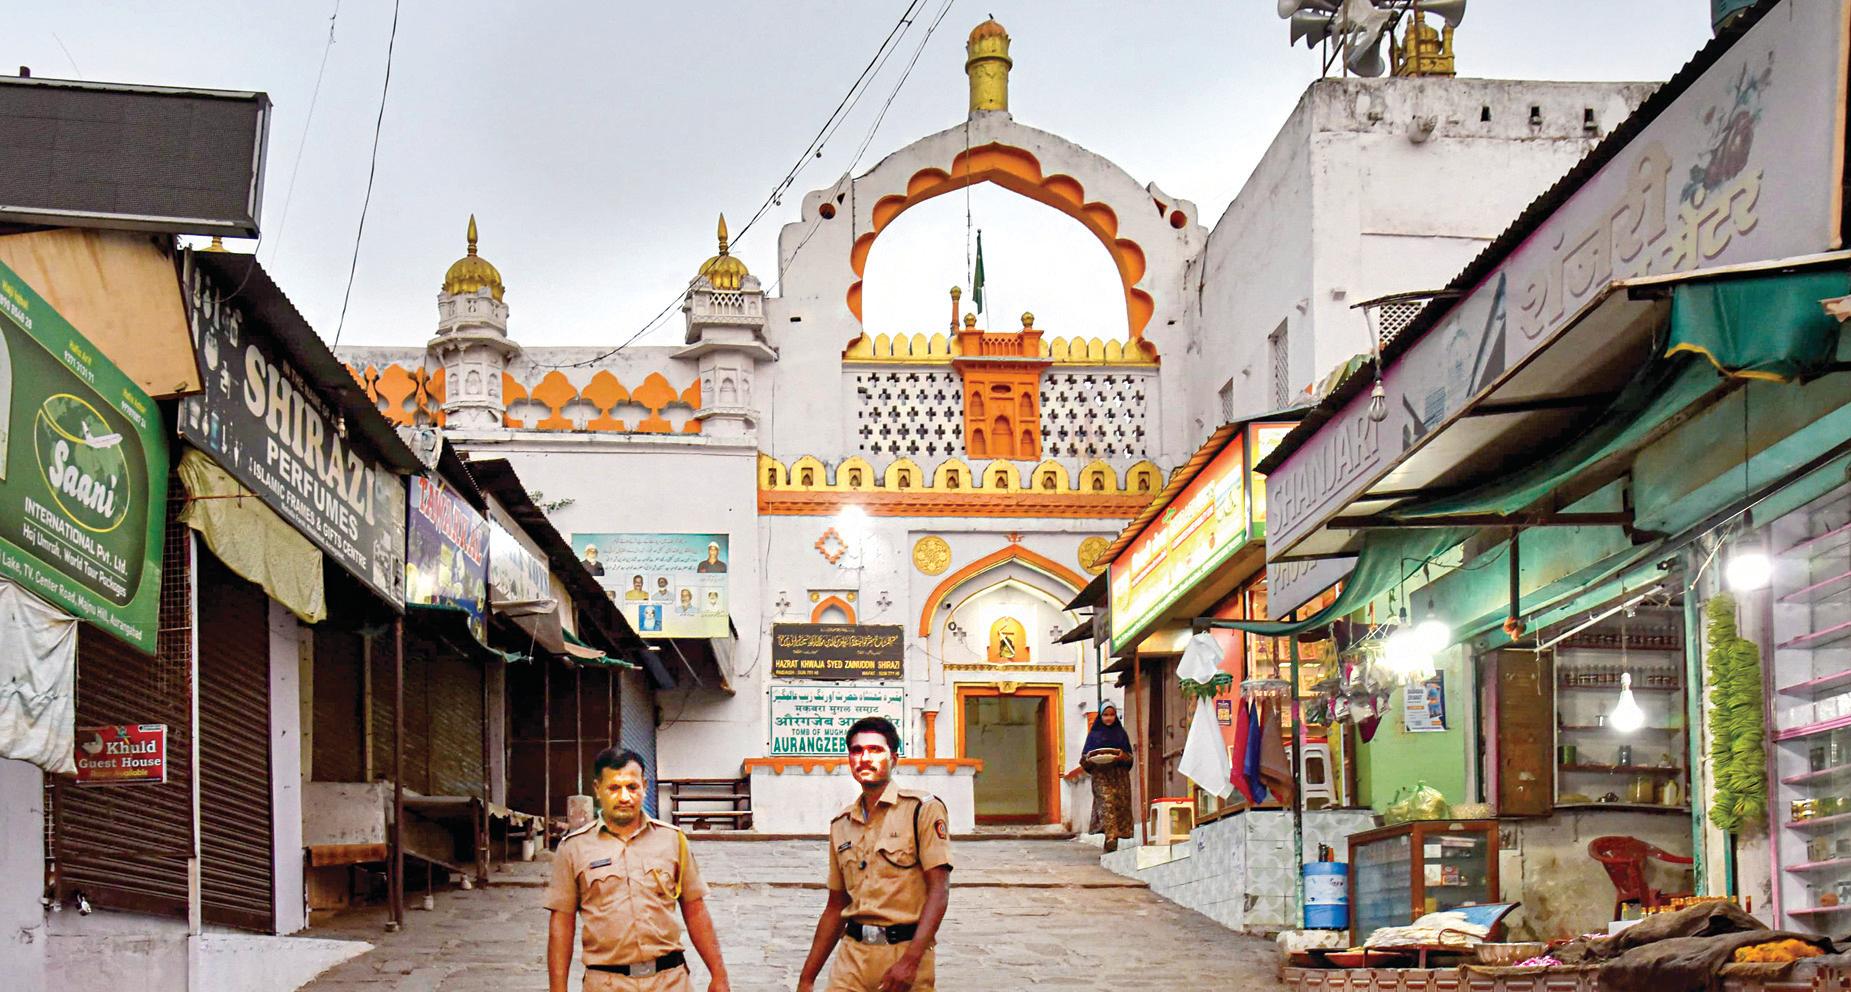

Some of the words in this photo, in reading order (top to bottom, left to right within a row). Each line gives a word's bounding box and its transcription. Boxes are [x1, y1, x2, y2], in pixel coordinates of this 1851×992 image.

[243, 344, 376, 527] SHIRAZI
[49, 440, 117, 518] Saani
[266, 436, 359, 541] PERFUMES
[1272, 415, 1380, 537] SHANJARI
[25, 496, 95, 555] INTERNATIONAL
[97, 544, 112, 566] Pvt.
[114, 555, 128, 576] Ltd.
[253, 461, 285, 500] ISLAMIC
[286, 490, 315, 526] FRAMES
[316, 516, 322, 532] &
[323, 523, 341, 549] GIFTS
[342, 540, 367, 570] CENTRE
[2, 552, 22, 575] Lake,
[35, 571, 58, 592] Center
[23, 523, 36, 545] Haj
[63, 548, 83, 571] World
[84, 562, 98, 580] Tour
[98, 571, 127, 598] Packages
[775, 660, 798, 669] HAZRAT
[800, 660, 825, 669] KHWAJA
[827, 660, 843, 669] SYED
[844, 660, 875, 669] ZAINUDDIN
[878, 660, 901, 670] SHIRAZI
[106, 740, 157, 755] Khuld
[773, 737, 846, 752] AURANGZEB
[794, 705, 826, 713] मकबरा
[829, 705, 851, 716] मुगल
[79, 758, 117, 768] Guest
[121, 757, 161, 768] House
